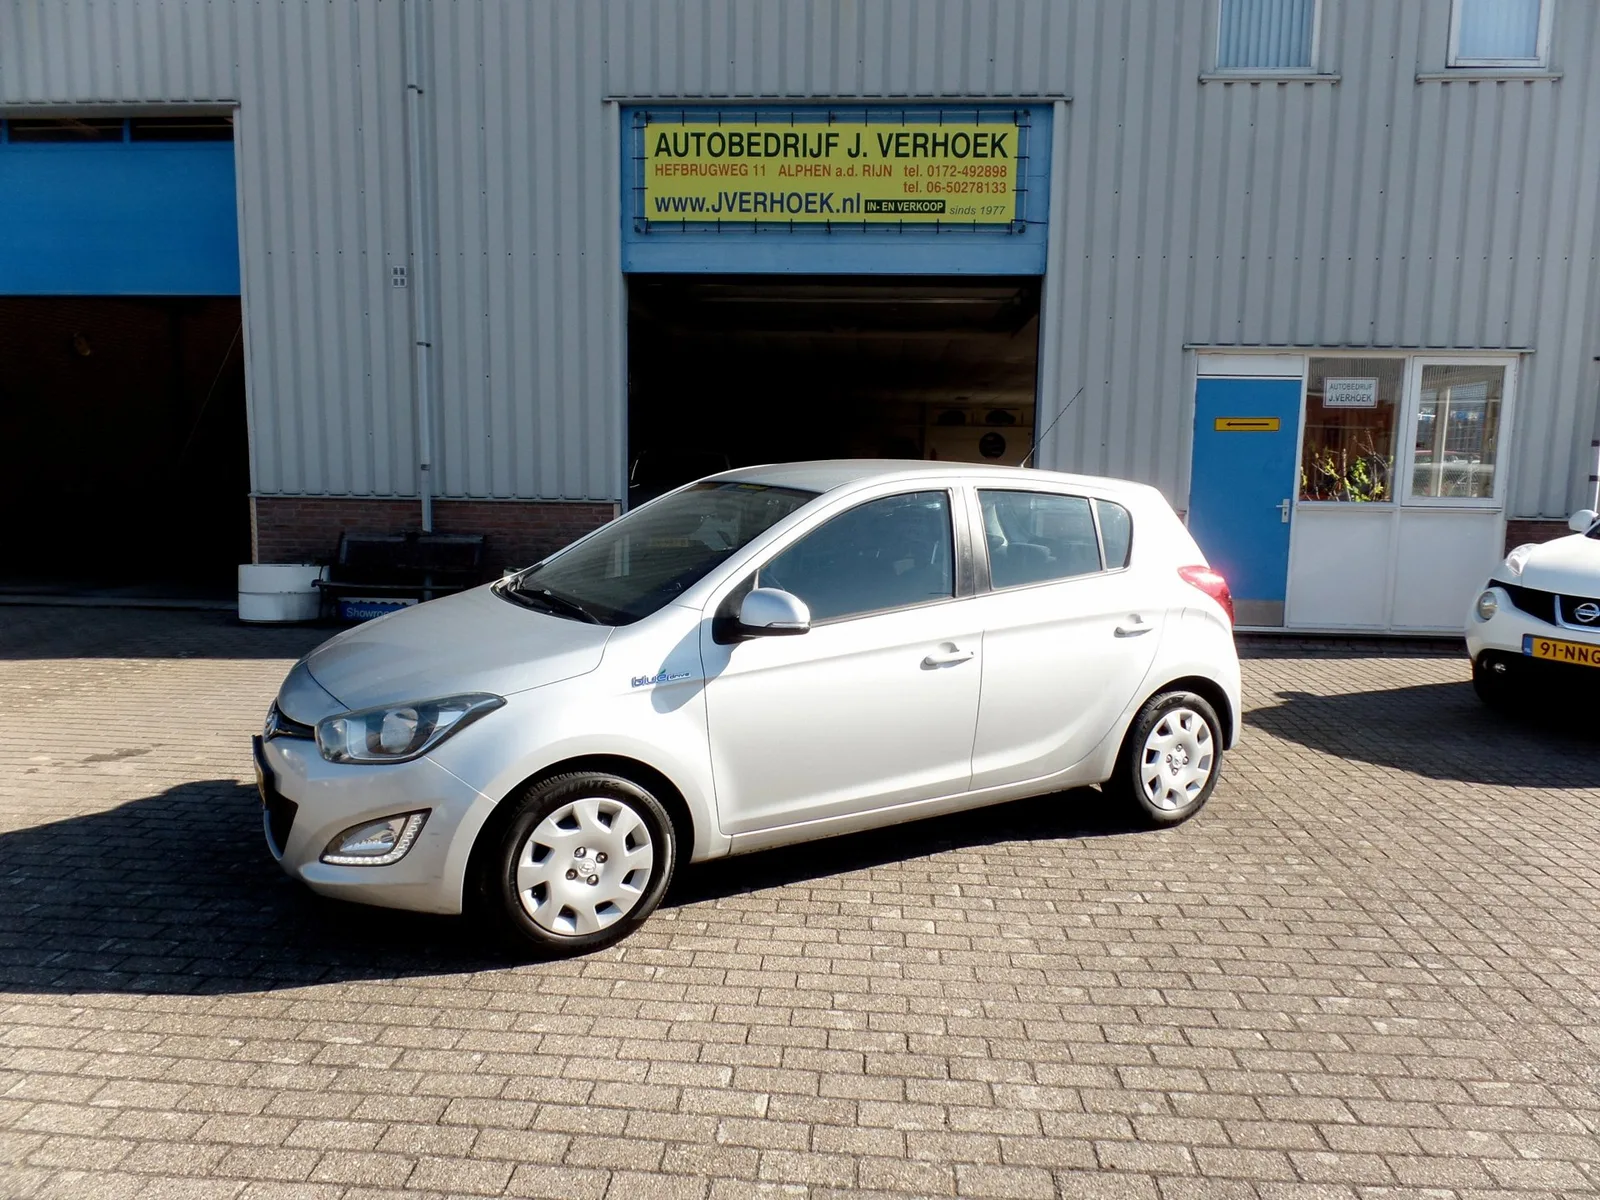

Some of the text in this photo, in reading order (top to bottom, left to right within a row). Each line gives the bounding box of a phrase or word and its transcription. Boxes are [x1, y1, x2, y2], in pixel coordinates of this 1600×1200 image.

[654, 132, 1008, 158] AUTOBEDRIJF J. VERHOEK
[655, 163, 1007, 178] HEFBRUGWEG 11 ALPHEN a.d. RIJN tel. 0172-492898
[903, 181, 1007, 194] tel. 06-50278133
[867, 202, 944, 212] IN- EN VERKOOP
[950, 206, 1006, 215] sinds 1977
[1329, 383, 1373, 391] AUTOBEDRIJF
[1329, 394, 1372, 402] J.VERHOEK
